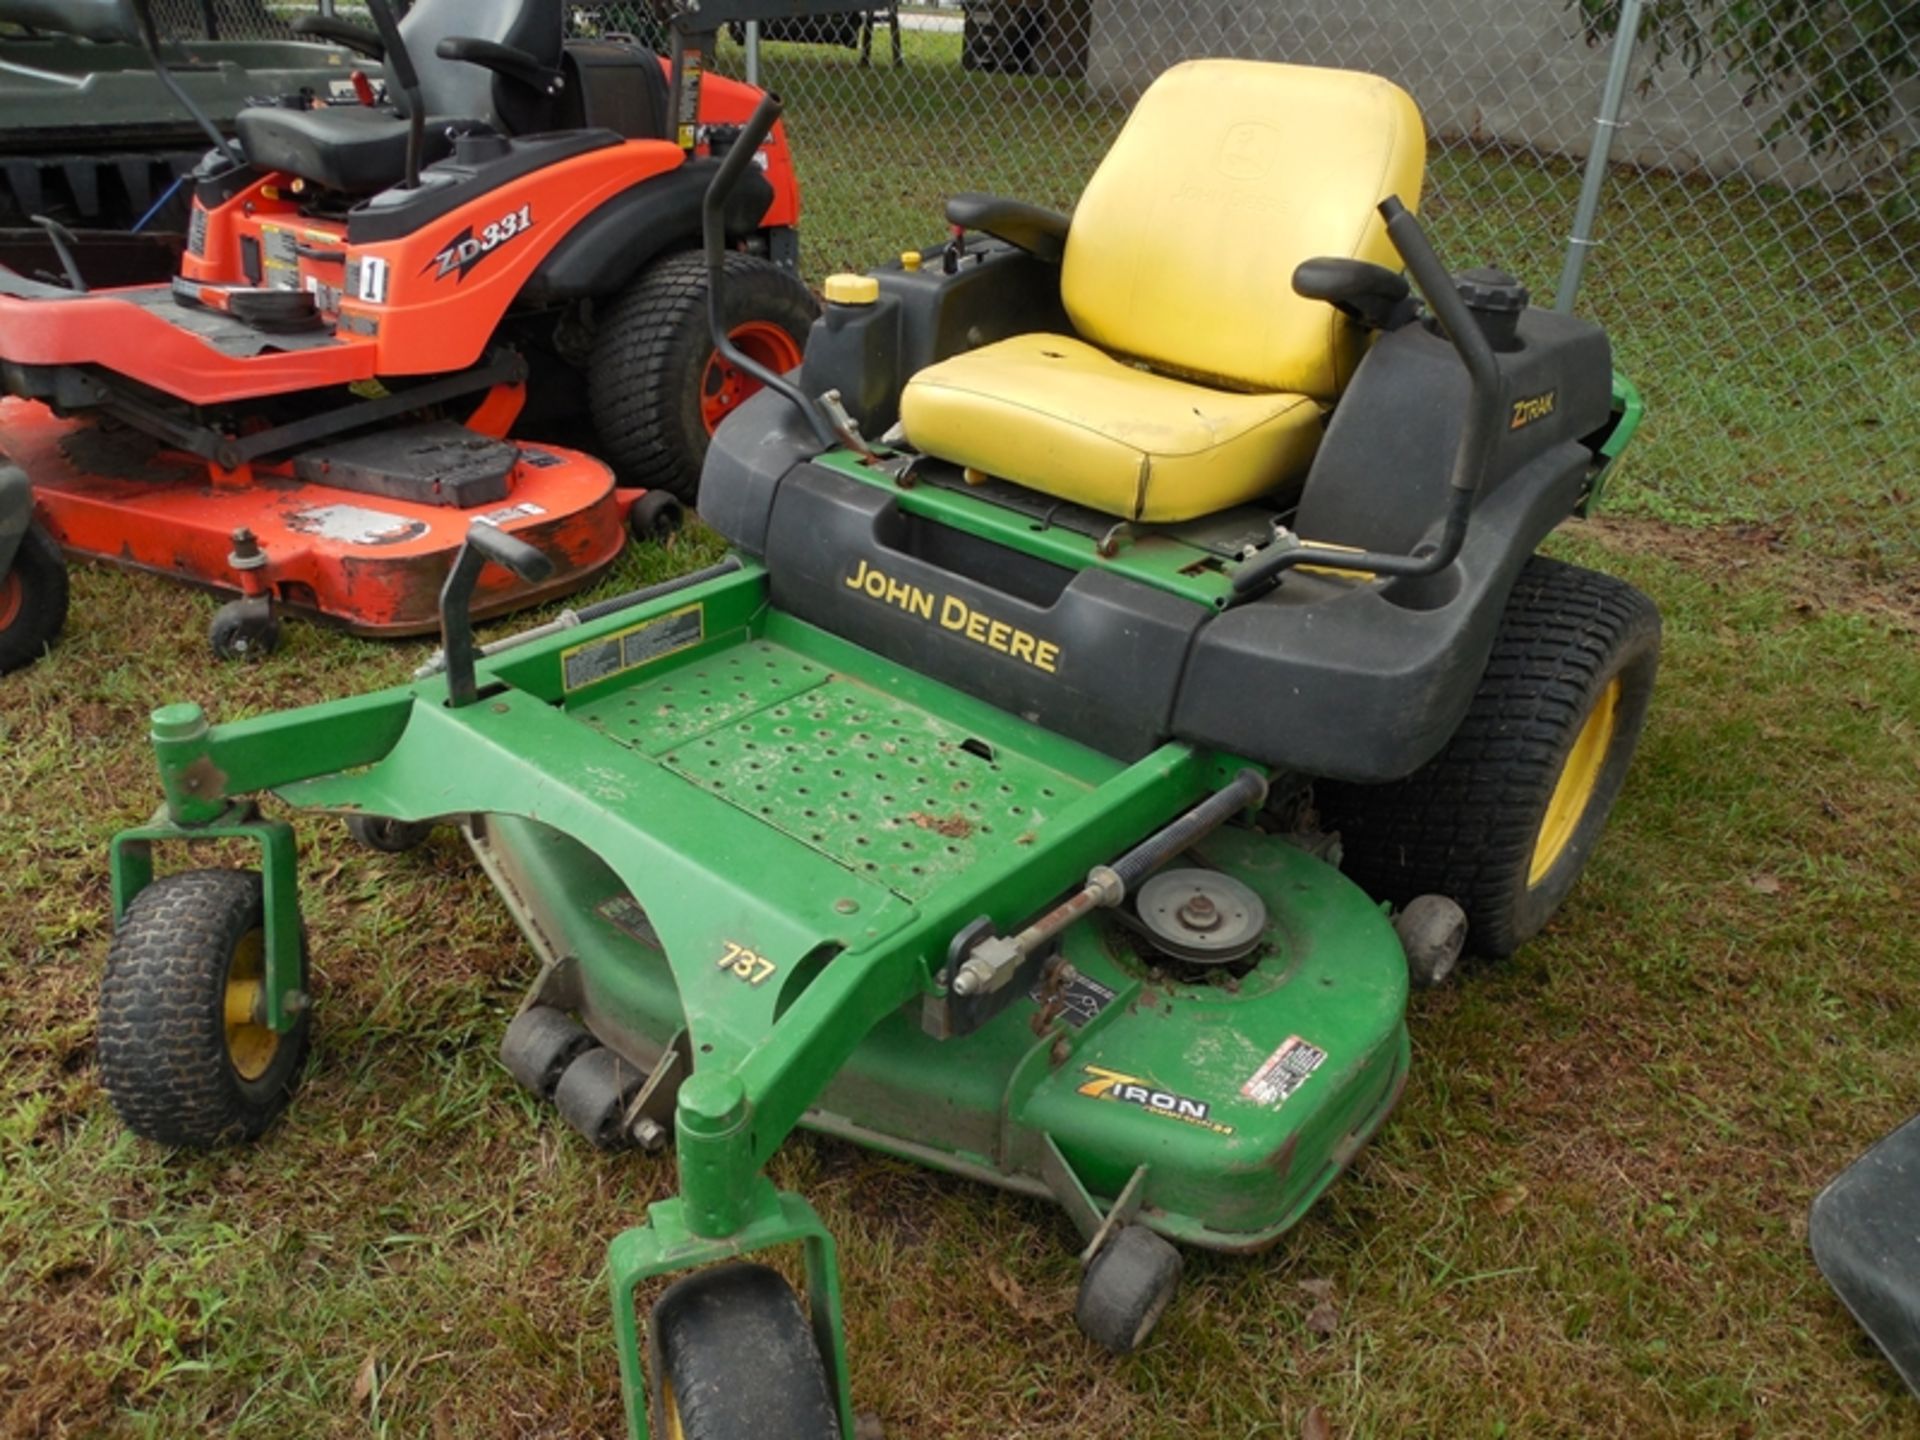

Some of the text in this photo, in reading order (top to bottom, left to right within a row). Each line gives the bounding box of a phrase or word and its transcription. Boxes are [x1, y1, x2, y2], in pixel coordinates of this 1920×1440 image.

[435, 203, 532, 277] ZD331
[365, 260, 378, 300] 1
[845, 559, 1060, 673] JOHN DEERE
[717, 940, 777, 985] 737
